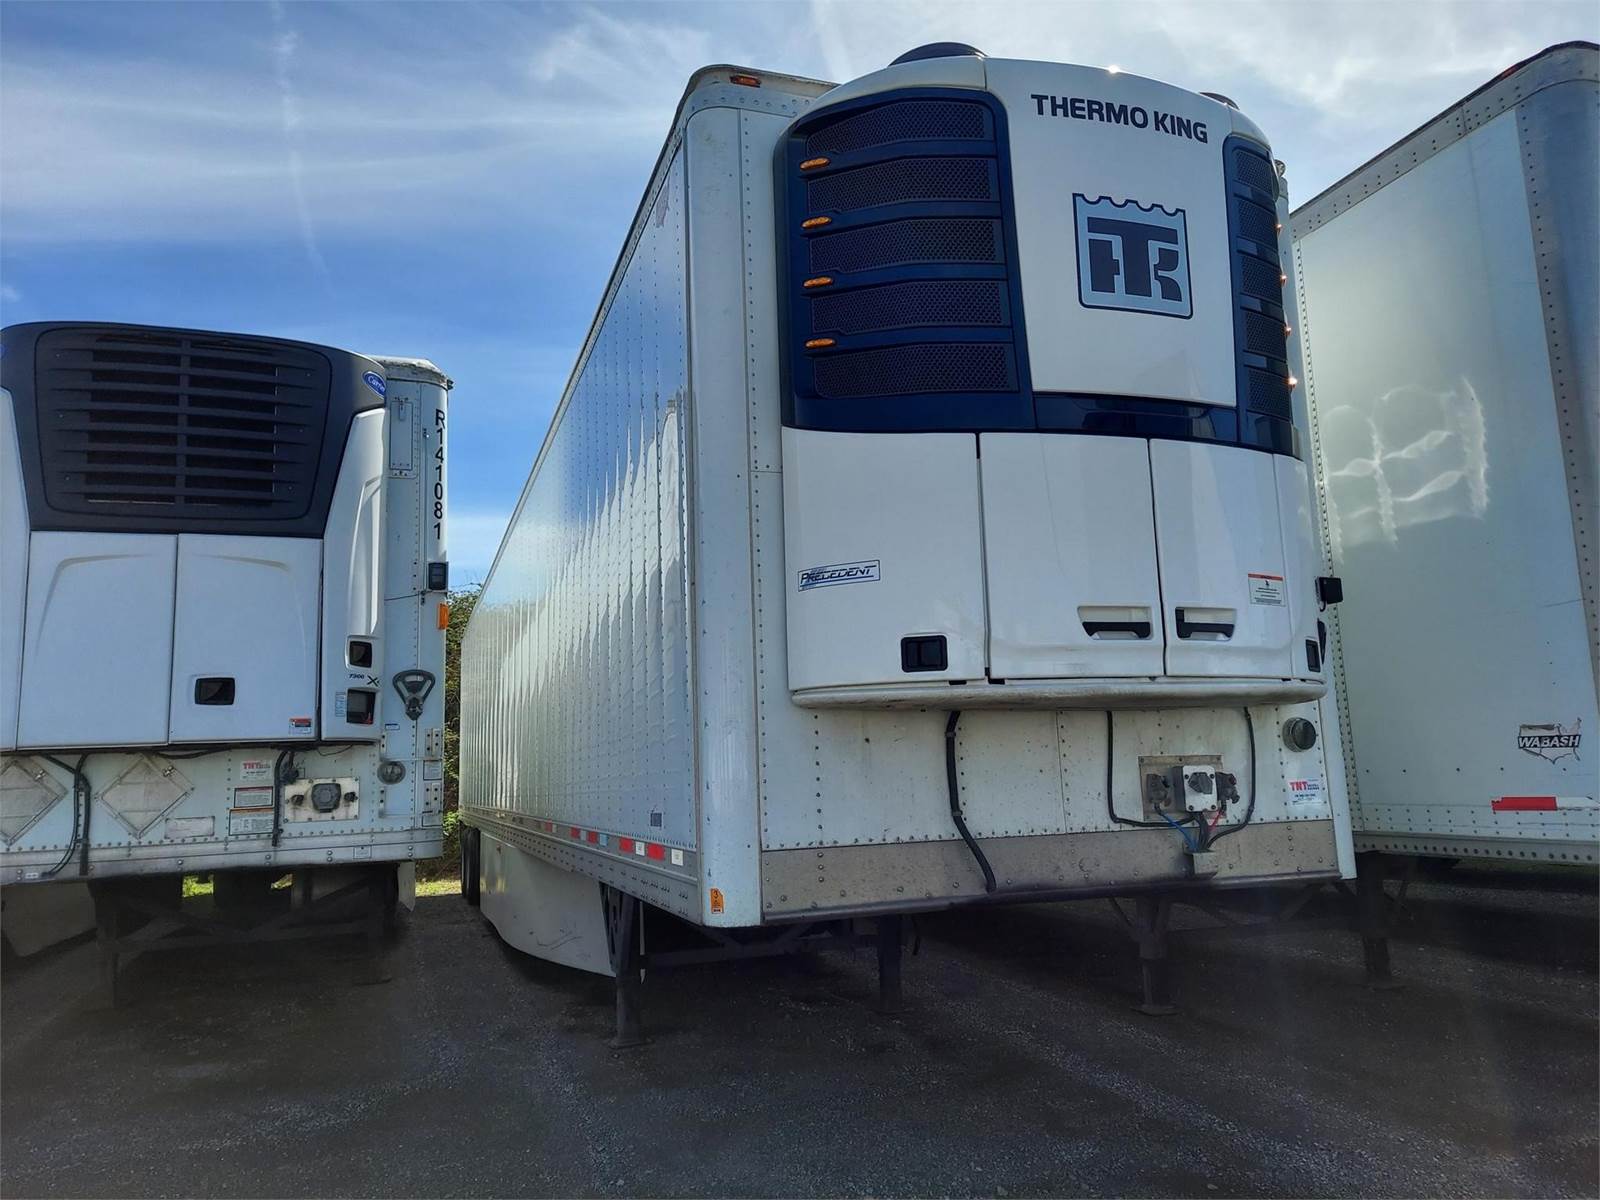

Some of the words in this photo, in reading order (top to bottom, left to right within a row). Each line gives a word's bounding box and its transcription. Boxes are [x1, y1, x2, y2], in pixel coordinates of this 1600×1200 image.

[1031, 94, 1149, 129] THERMO
[1154, 110, 1208, 144] KING
[433, 408, 446, 540] R141081
[800, 565, 877, 585] PRECEDENT
[1518, 735, 1580, 748] WABASH
